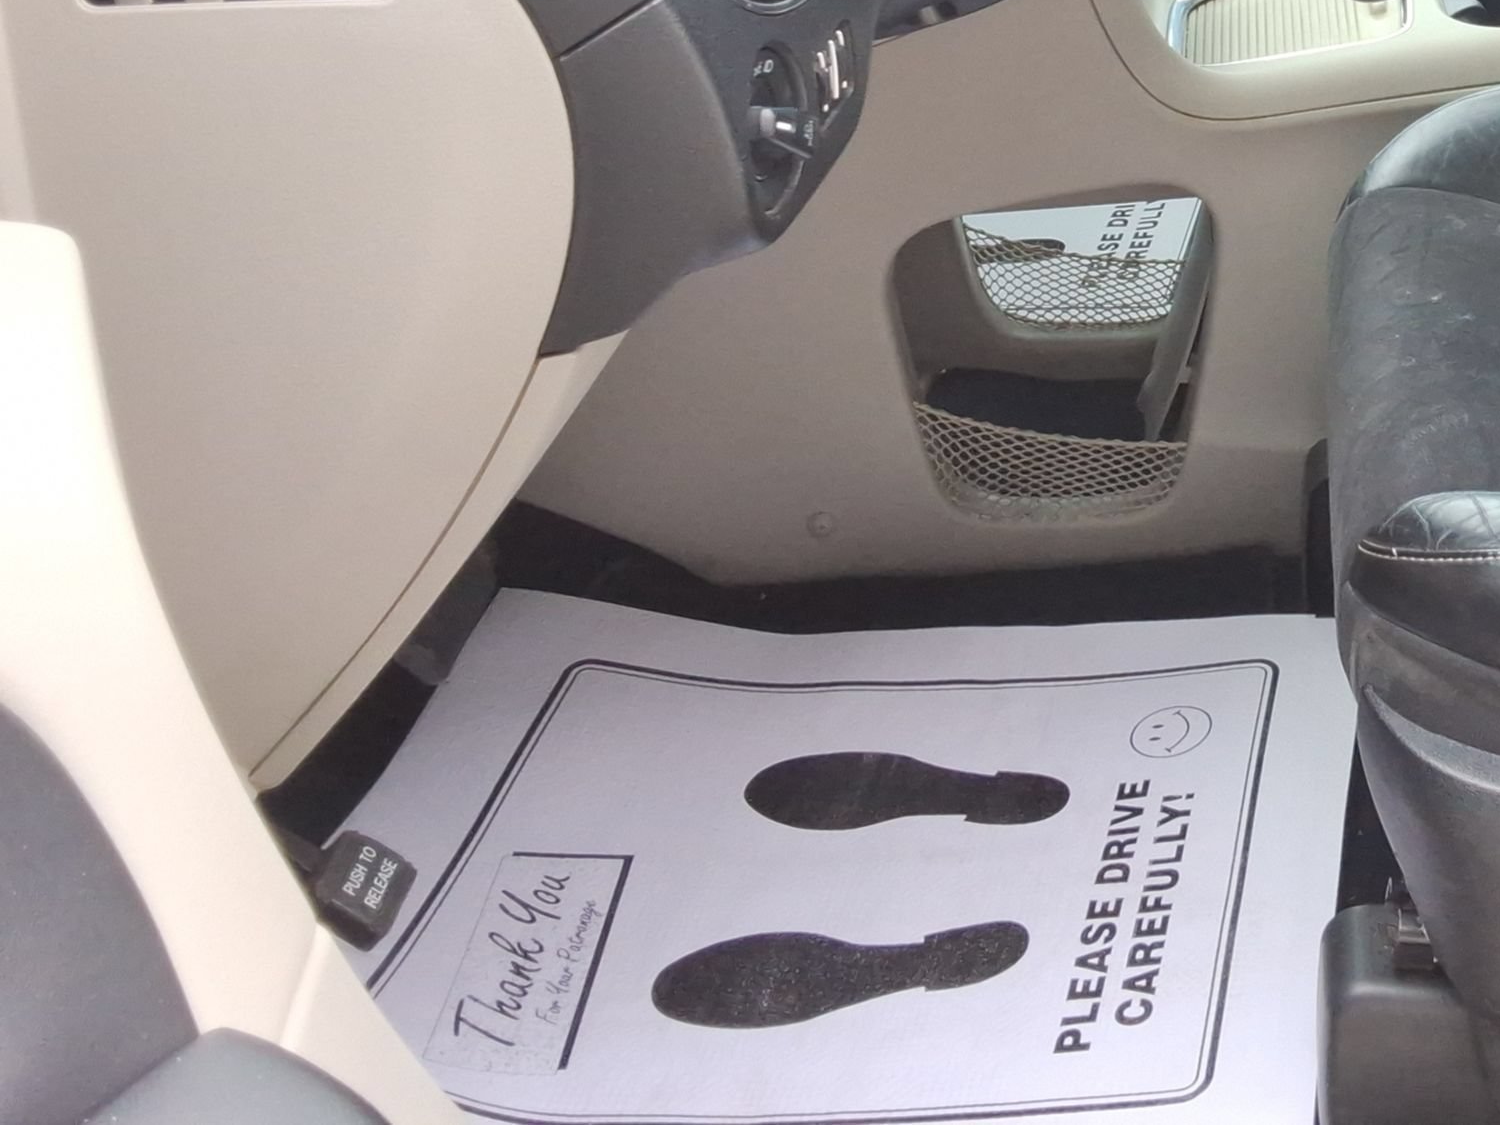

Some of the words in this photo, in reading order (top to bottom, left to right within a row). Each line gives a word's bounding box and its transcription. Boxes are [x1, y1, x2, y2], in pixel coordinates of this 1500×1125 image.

[342, 863, 368, 896] PUSH
[359, 846, 377, 863] TO
[363, 858, 398, 909] RELEASE
[556, 900, 603, 963] Patronage
[1053, 897, 1124, 1054] PLEASE
[1094, 779, 1151, 885] DRIVE
[1114, 792, 1195, 1026] CAREFULLY!
[454, 931, 544, 1047] Thank
[499, 875, 570, 924] You
[546, 966, 574, 995] Your
[535, 1000, 560, 1025] For
